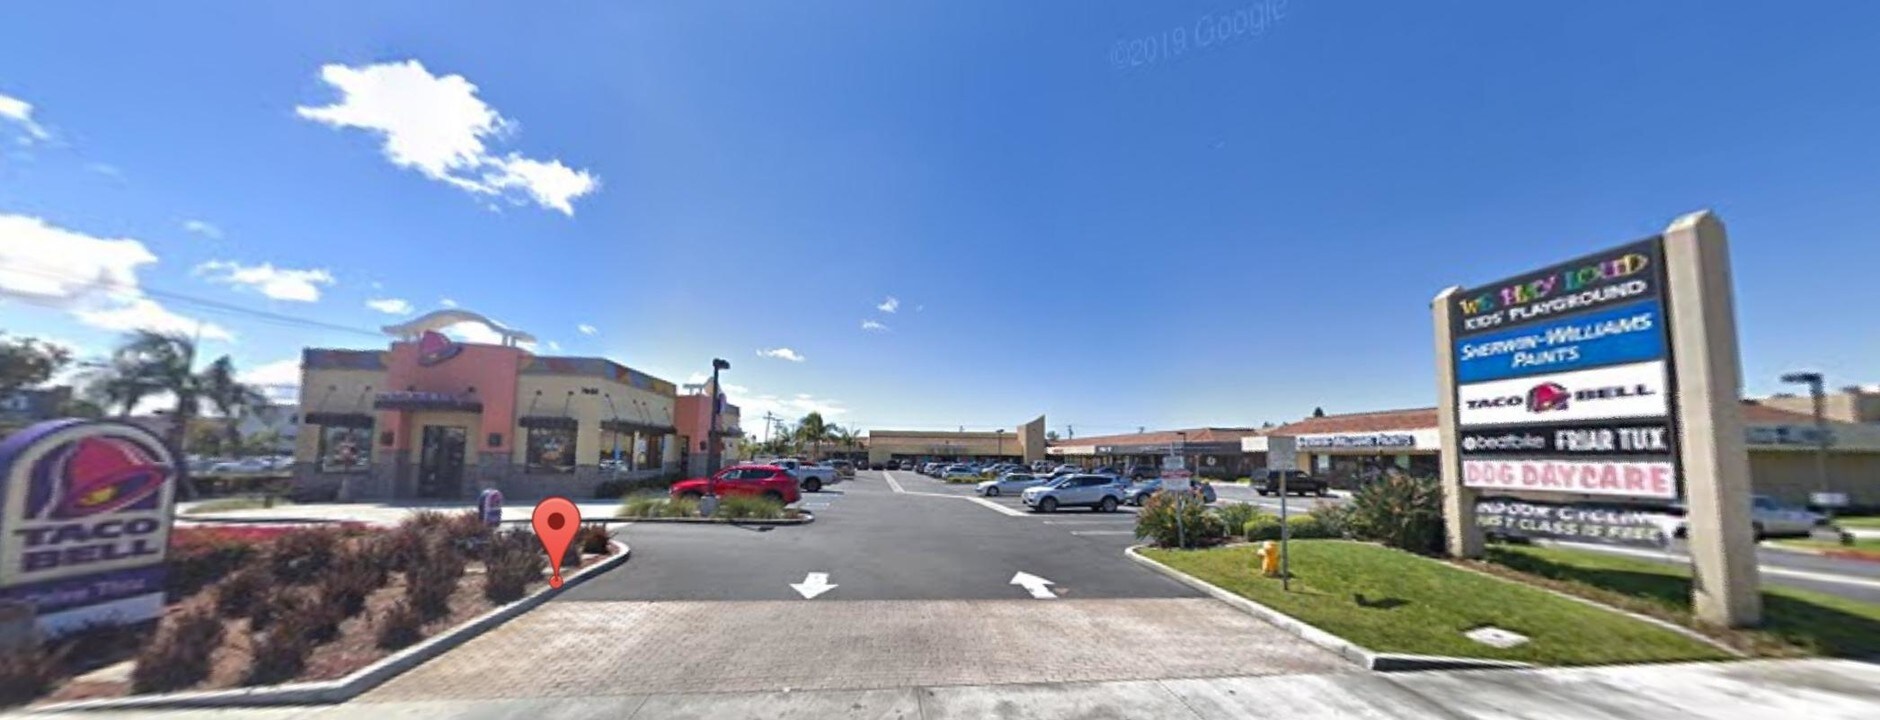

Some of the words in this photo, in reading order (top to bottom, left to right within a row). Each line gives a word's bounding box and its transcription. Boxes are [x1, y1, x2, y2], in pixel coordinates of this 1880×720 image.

[1510, 278, 1648, 322] PLAYGROUND
[1511, 345, 1581, 369] PAINTS
[1466, 395, 1524, 410] TACO
[1574, 383, 1656, 402] BELL
[1555, 429, 1614, 450] FRIAR
[1618, 427, 1668, 450] TUX
[1465, 462, 1515, 484] DOG
[1521, 464, 1671, 494] DAYCARE
[12, 517, 160, 546] TACO
[22, 540, 158, 571] BELL
